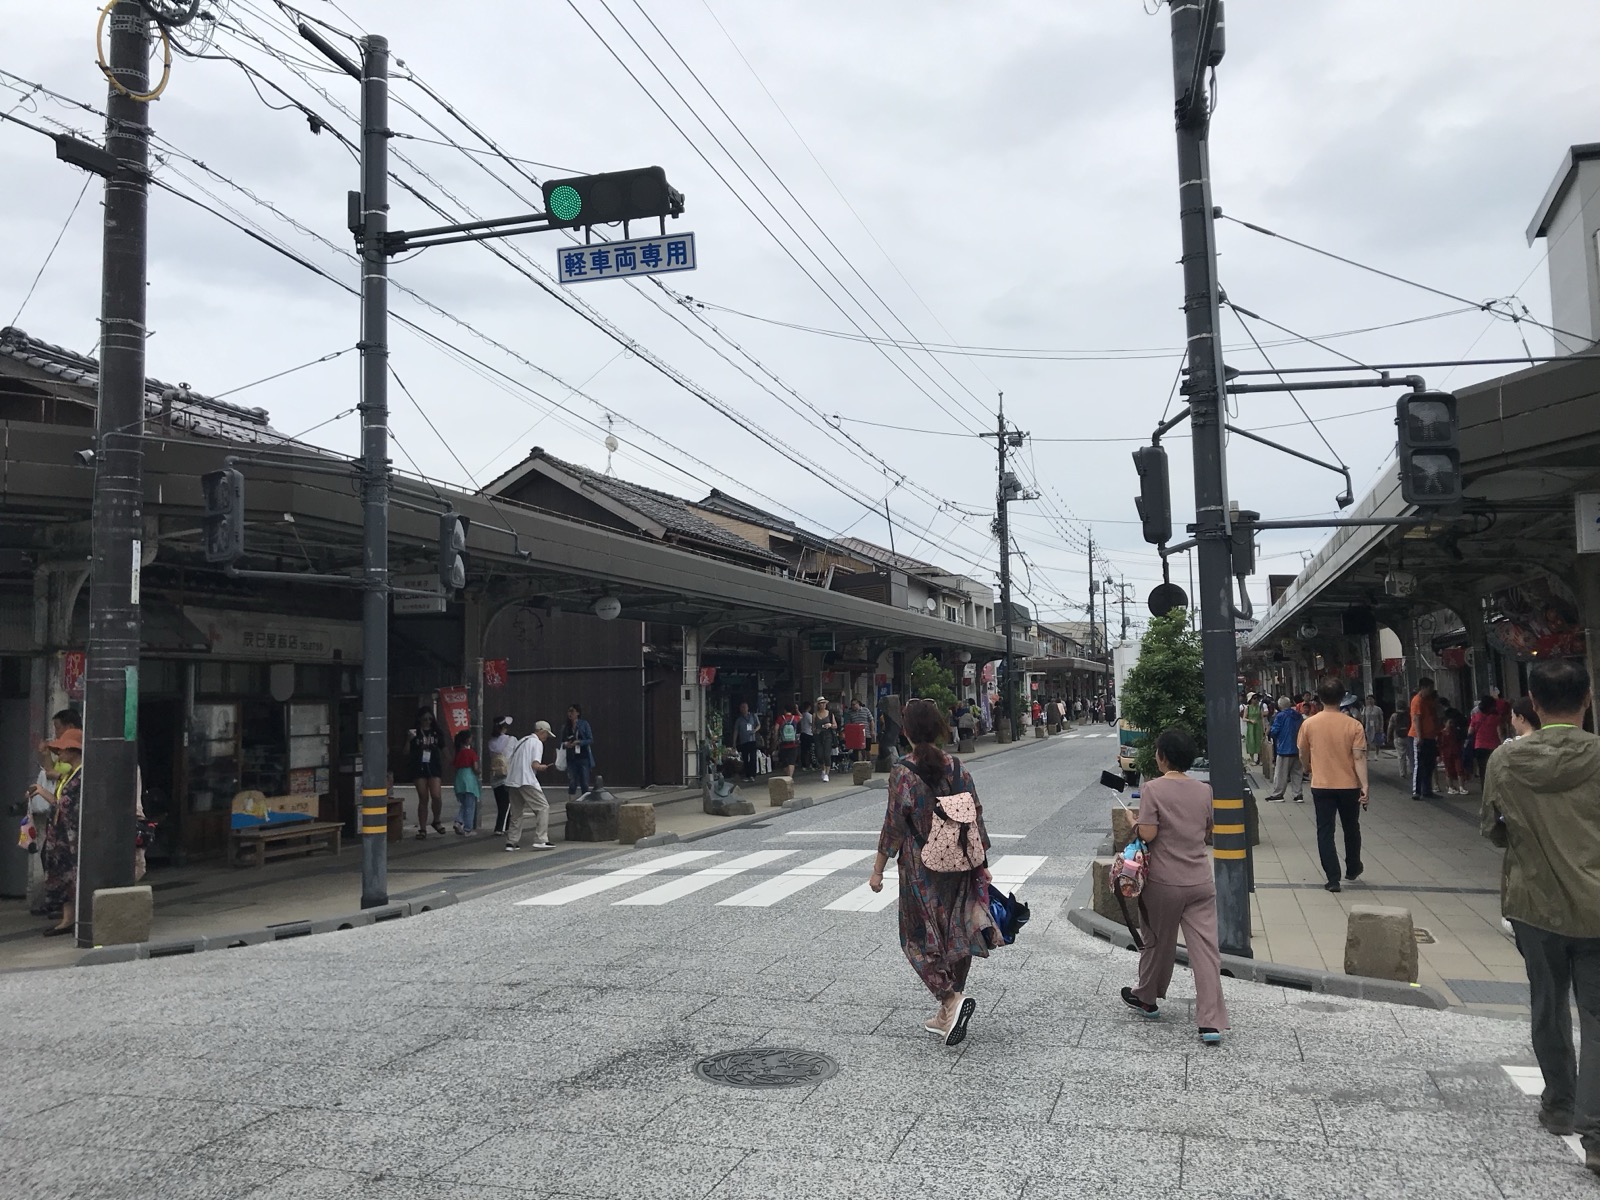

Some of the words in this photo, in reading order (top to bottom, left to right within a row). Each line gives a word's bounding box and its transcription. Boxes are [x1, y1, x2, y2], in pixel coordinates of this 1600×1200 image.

[563, 240, 688, 277] 軽車両専用
